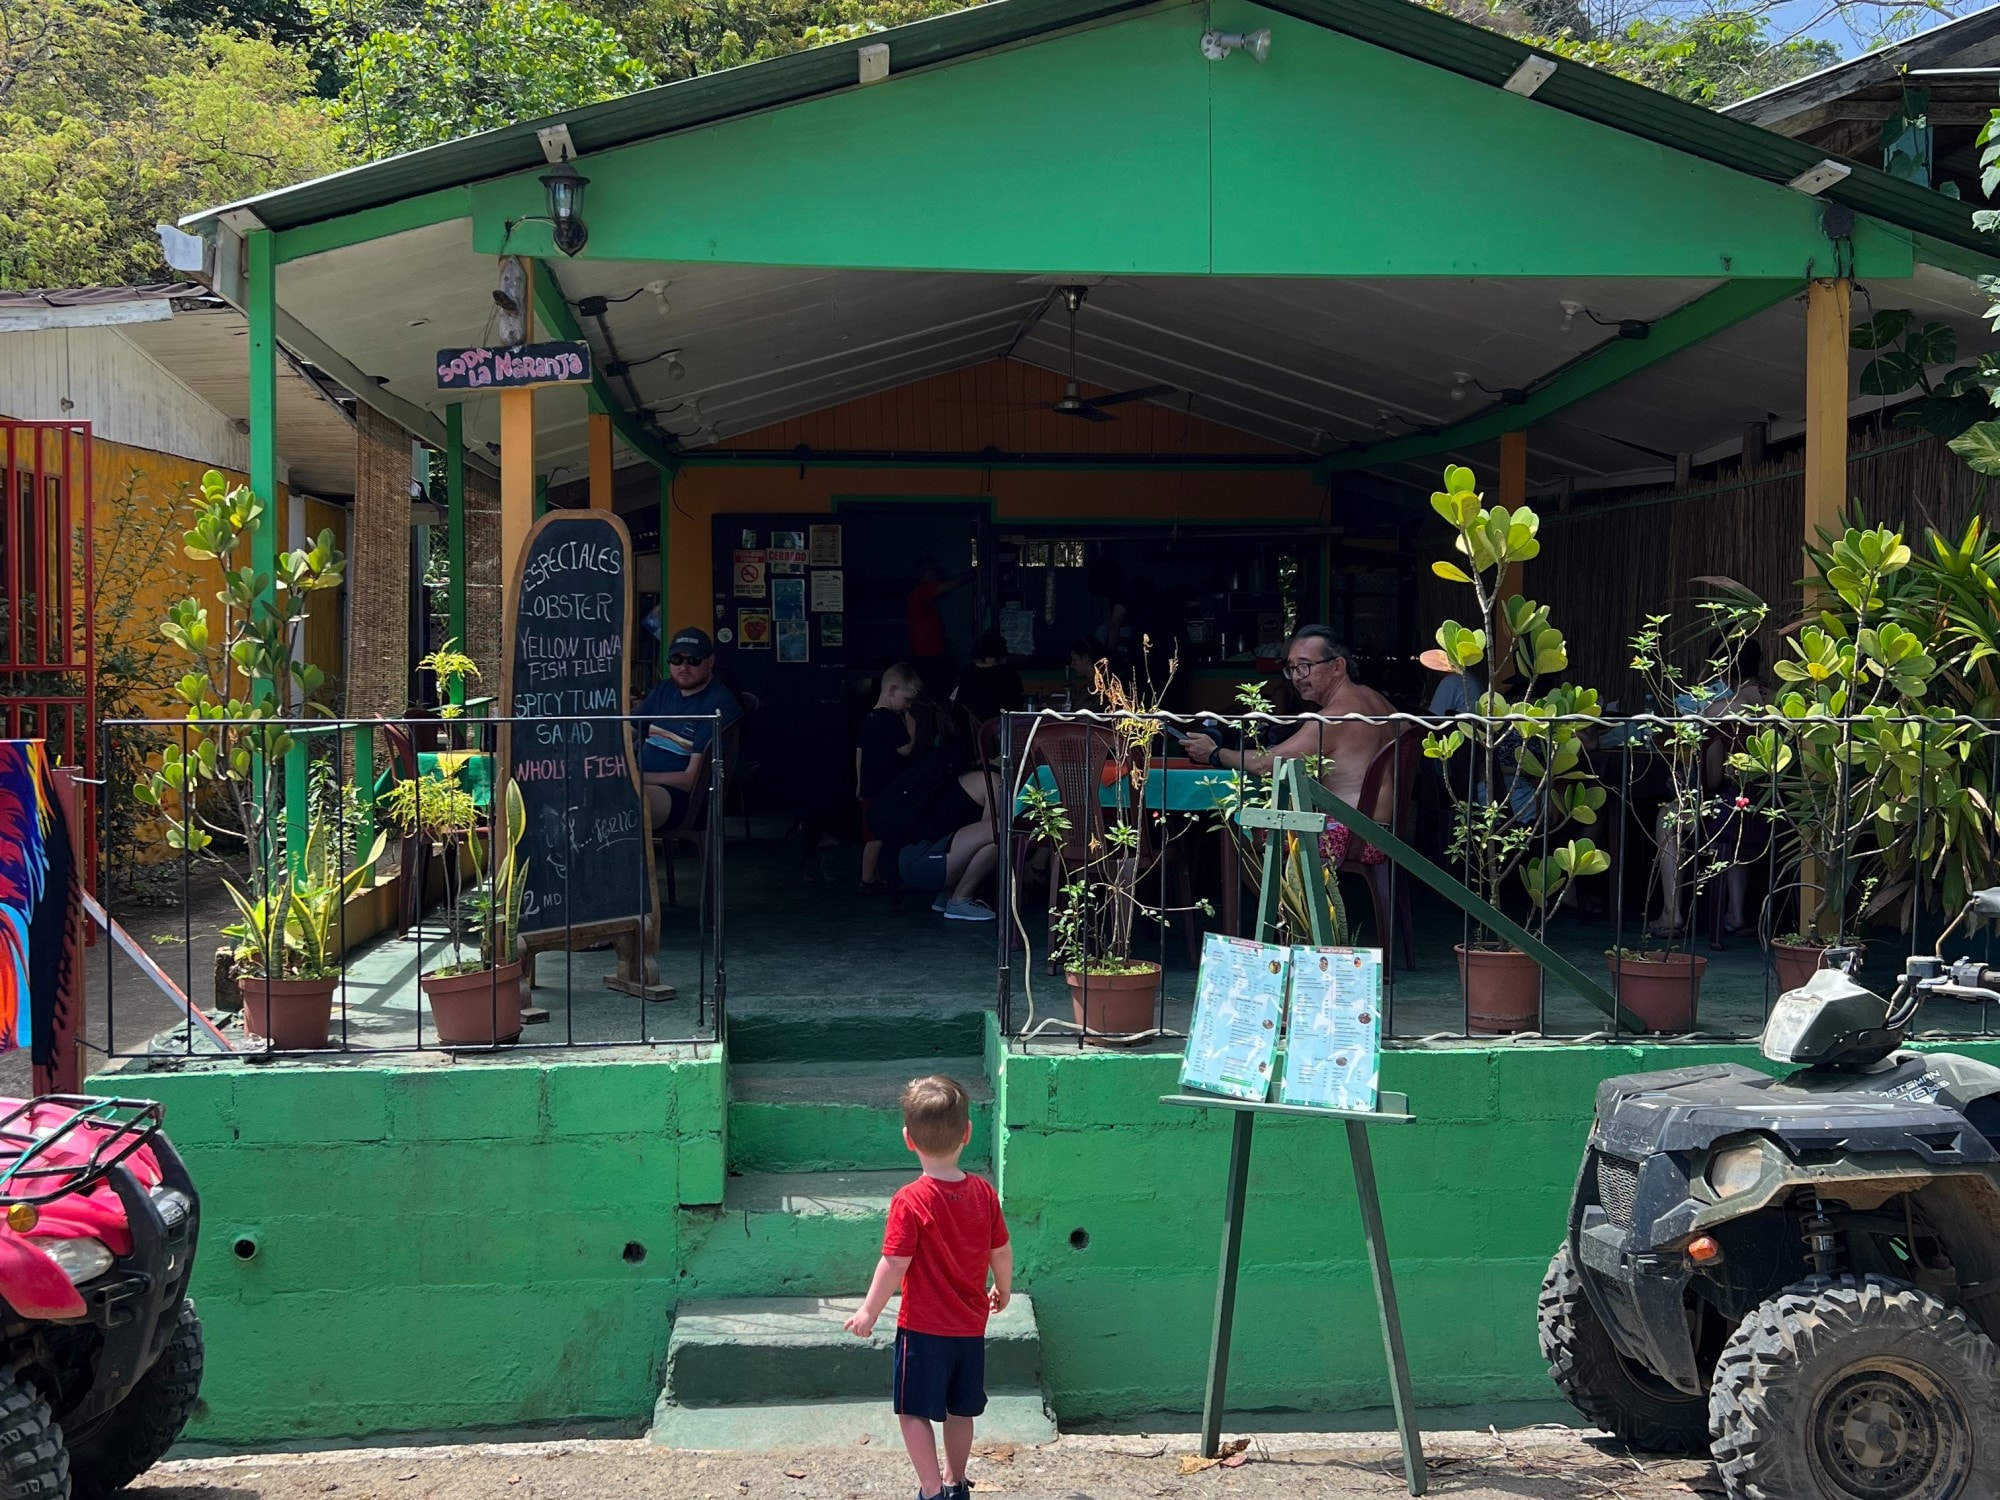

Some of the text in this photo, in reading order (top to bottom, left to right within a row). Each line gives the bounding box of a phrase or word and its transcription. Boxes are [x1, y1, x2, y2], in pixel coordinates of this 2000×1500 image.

[438, 348, 492, 383] SODA
[522, 541, 621, 593] ESPECIALES
[520, 593, 613, 623] LOBSTER
[519, 627, 622, 660] YELLOW TUNA
[528, 657, 614, 686] FISH FILET
[514, 688, 617, 718] SPICY TUNA
[536, 721, 594, 745] SAAD
[584, 754, 628, 780] FISH
